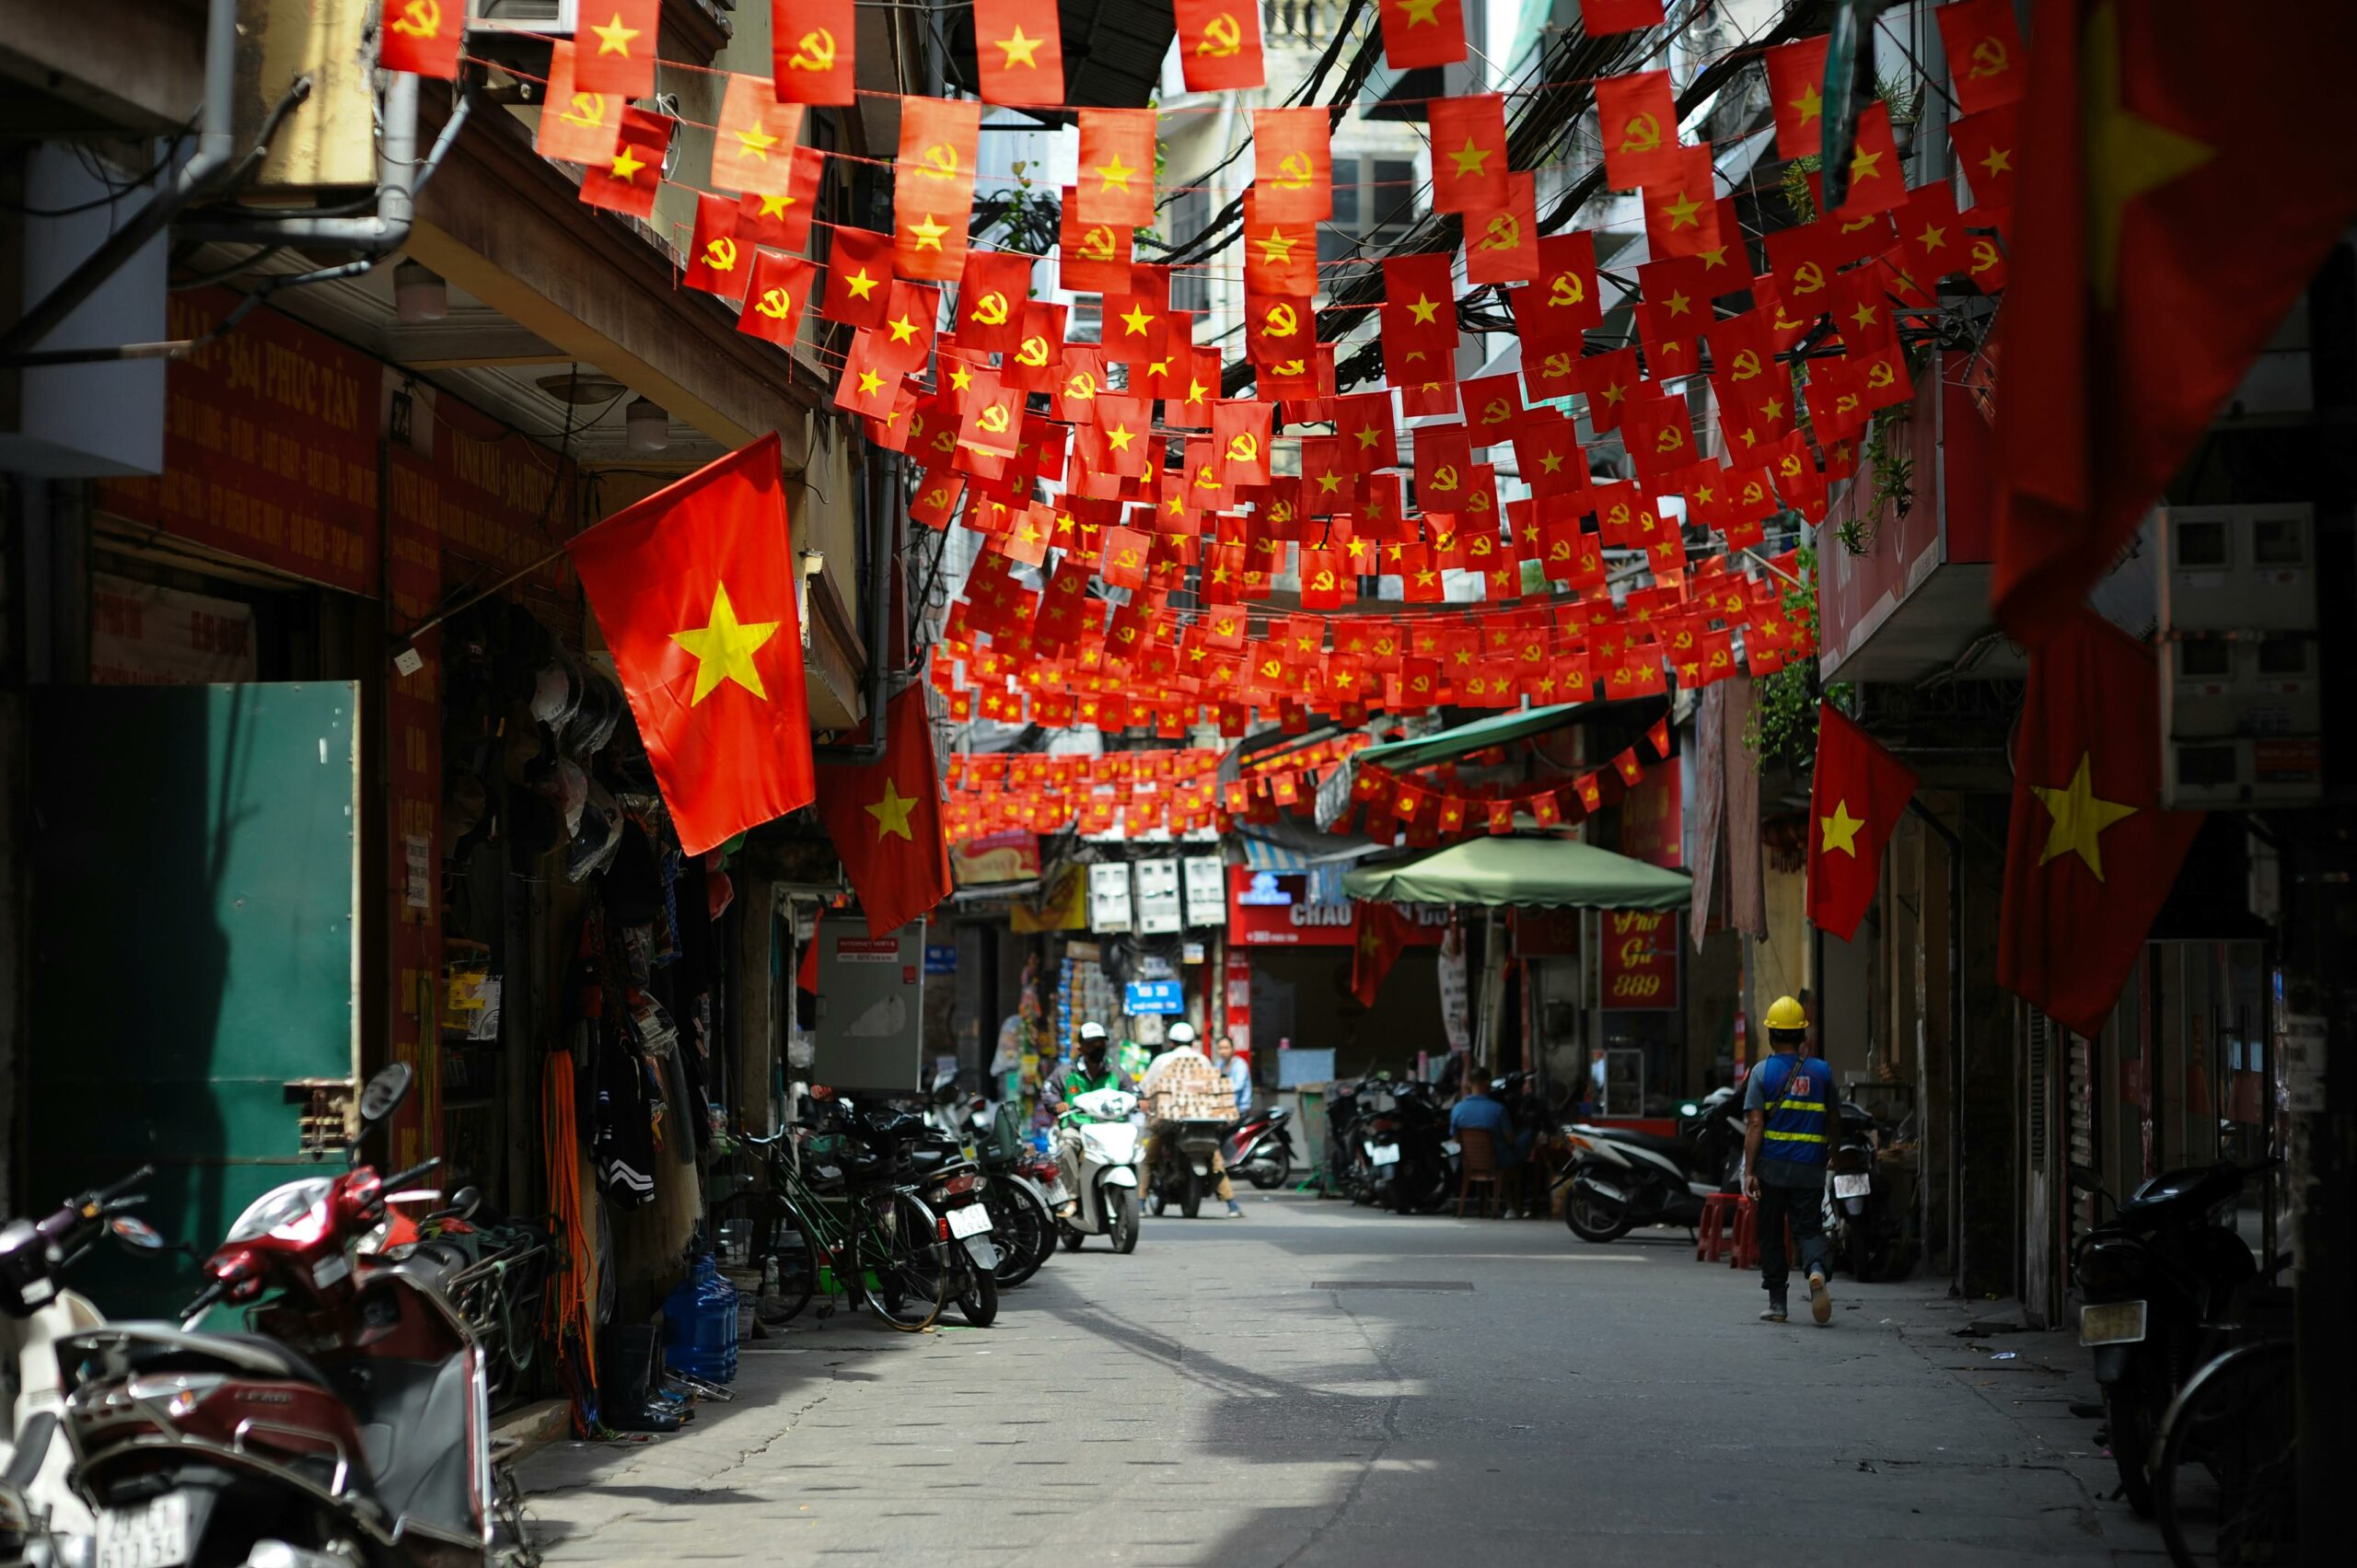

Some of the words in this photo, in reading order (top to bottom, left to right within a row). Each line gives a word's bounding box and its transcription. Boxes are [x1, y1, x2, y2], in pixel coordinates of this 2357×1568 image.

[226, 331, 260, 400] 364
[264, 337, 317, 416] PHÚC
[321, 355, 361, 436] TÂN
